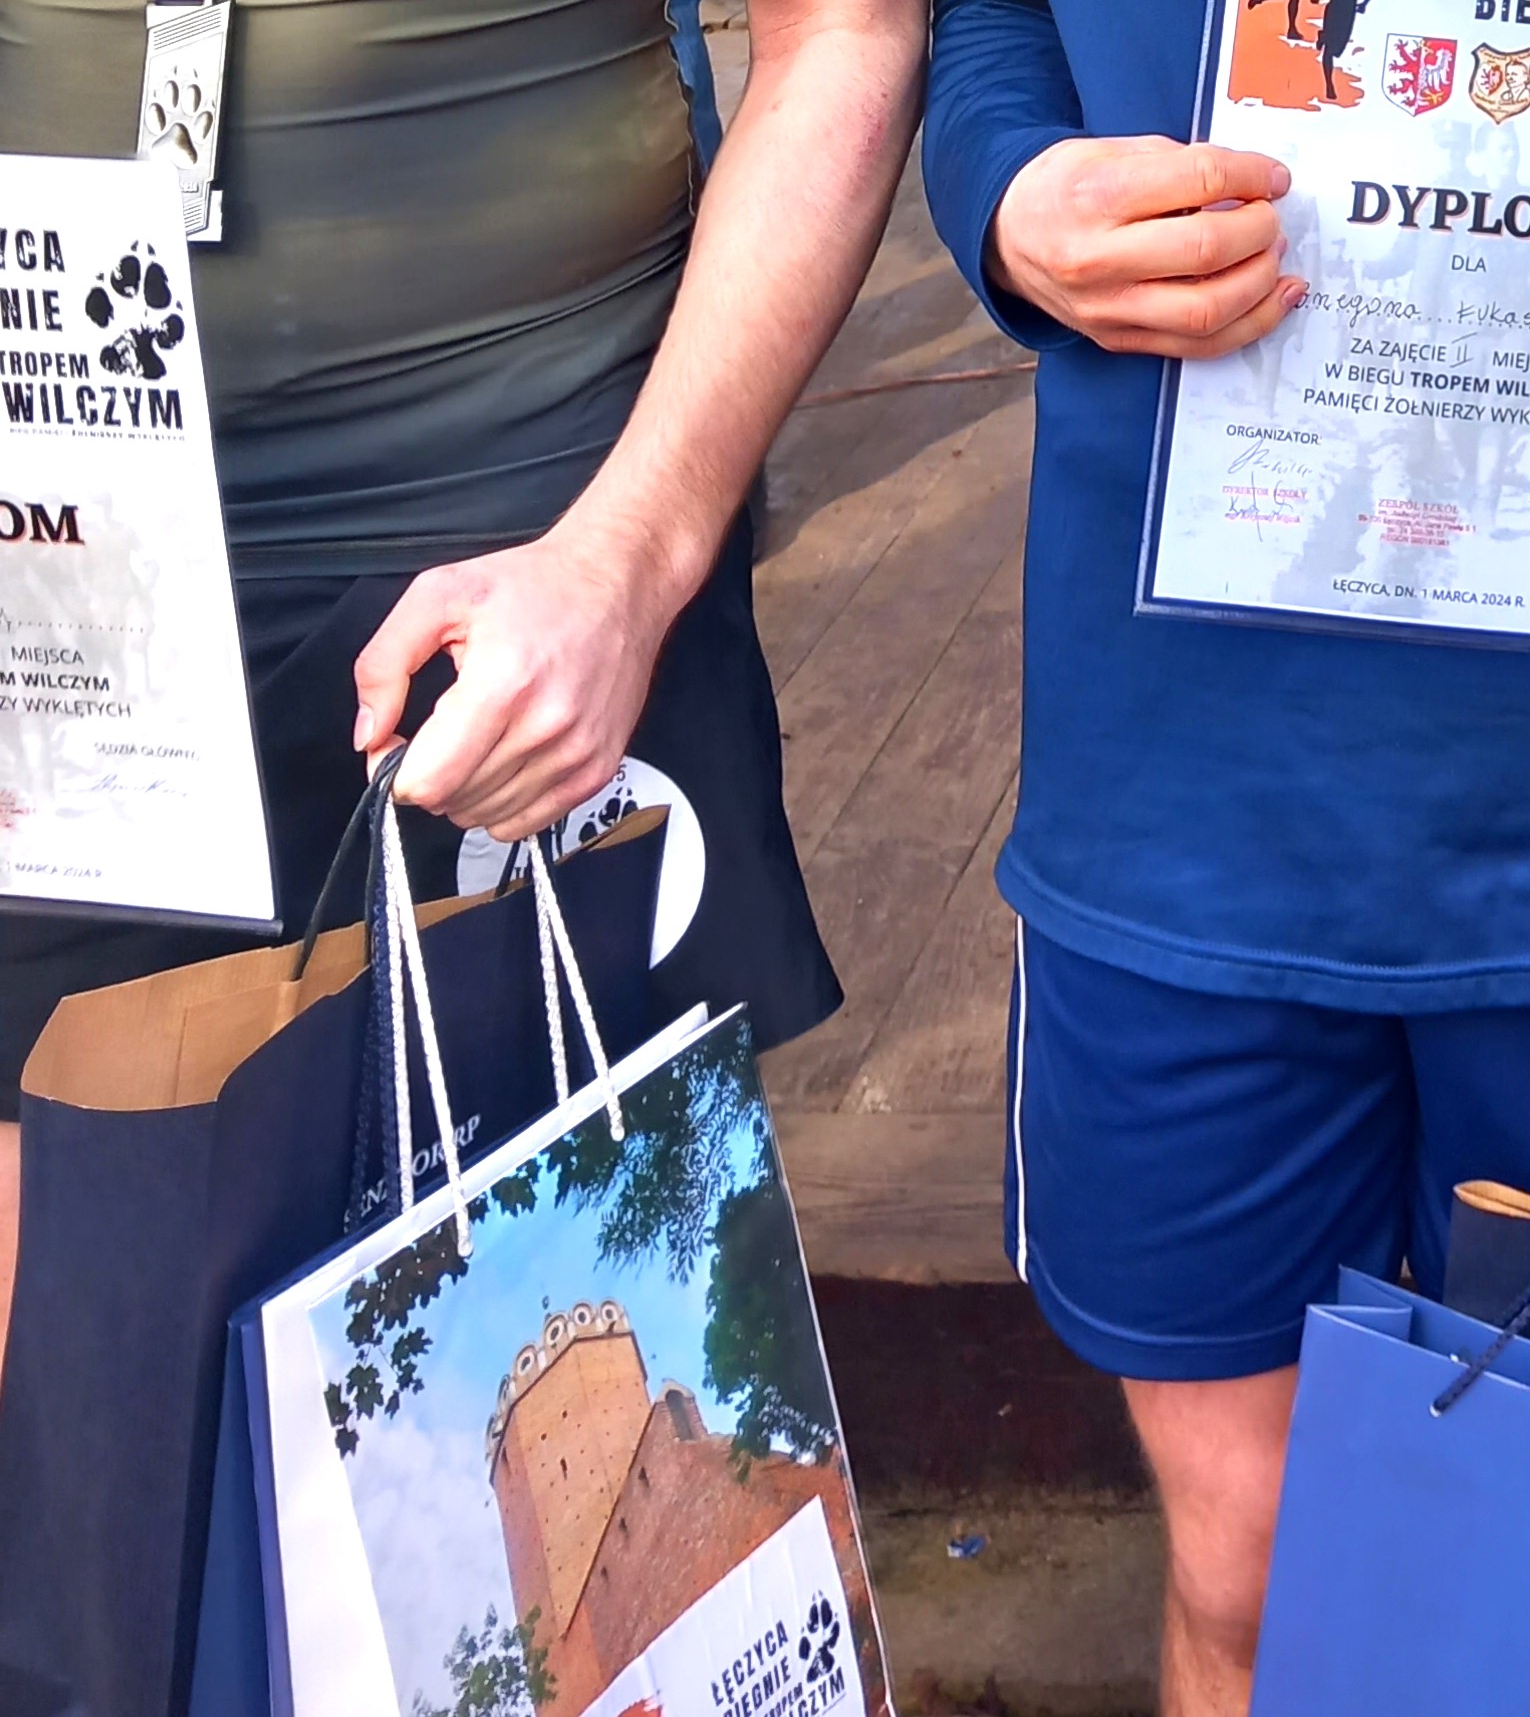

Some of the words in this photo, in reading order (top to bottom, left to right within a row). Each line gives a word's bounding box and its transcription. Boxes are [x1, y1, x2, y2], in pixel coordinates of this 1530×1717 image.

[1451, 254, 1487, 273] DLA
[1350, 337, 1374, 355] ZA
[1378, 340, 1447, 363] ZAJĘCIE
[1325, 363, 1343, 379] W
[1348, 365, 1404, 386] BIEGU
[1410, 371, 1490, 394] TROPEM
[1, 382, 184, 431] WILCZYM
[1303, 388, 1379, 414] PAMIĘCI
[1383, 392, 1486, 422] ŻOŁNIERZY
[1422, 588, 1428, 599] 1
[1432, 589, 1478, 604] MARCA
[1481, 593, 1512, 607] 2024
[11, 646, 85, 665] MIEJSCA
[21, 672, 110, 692] WILCZYM
[23, 697, 131, 718] WYKLĘTYCH
